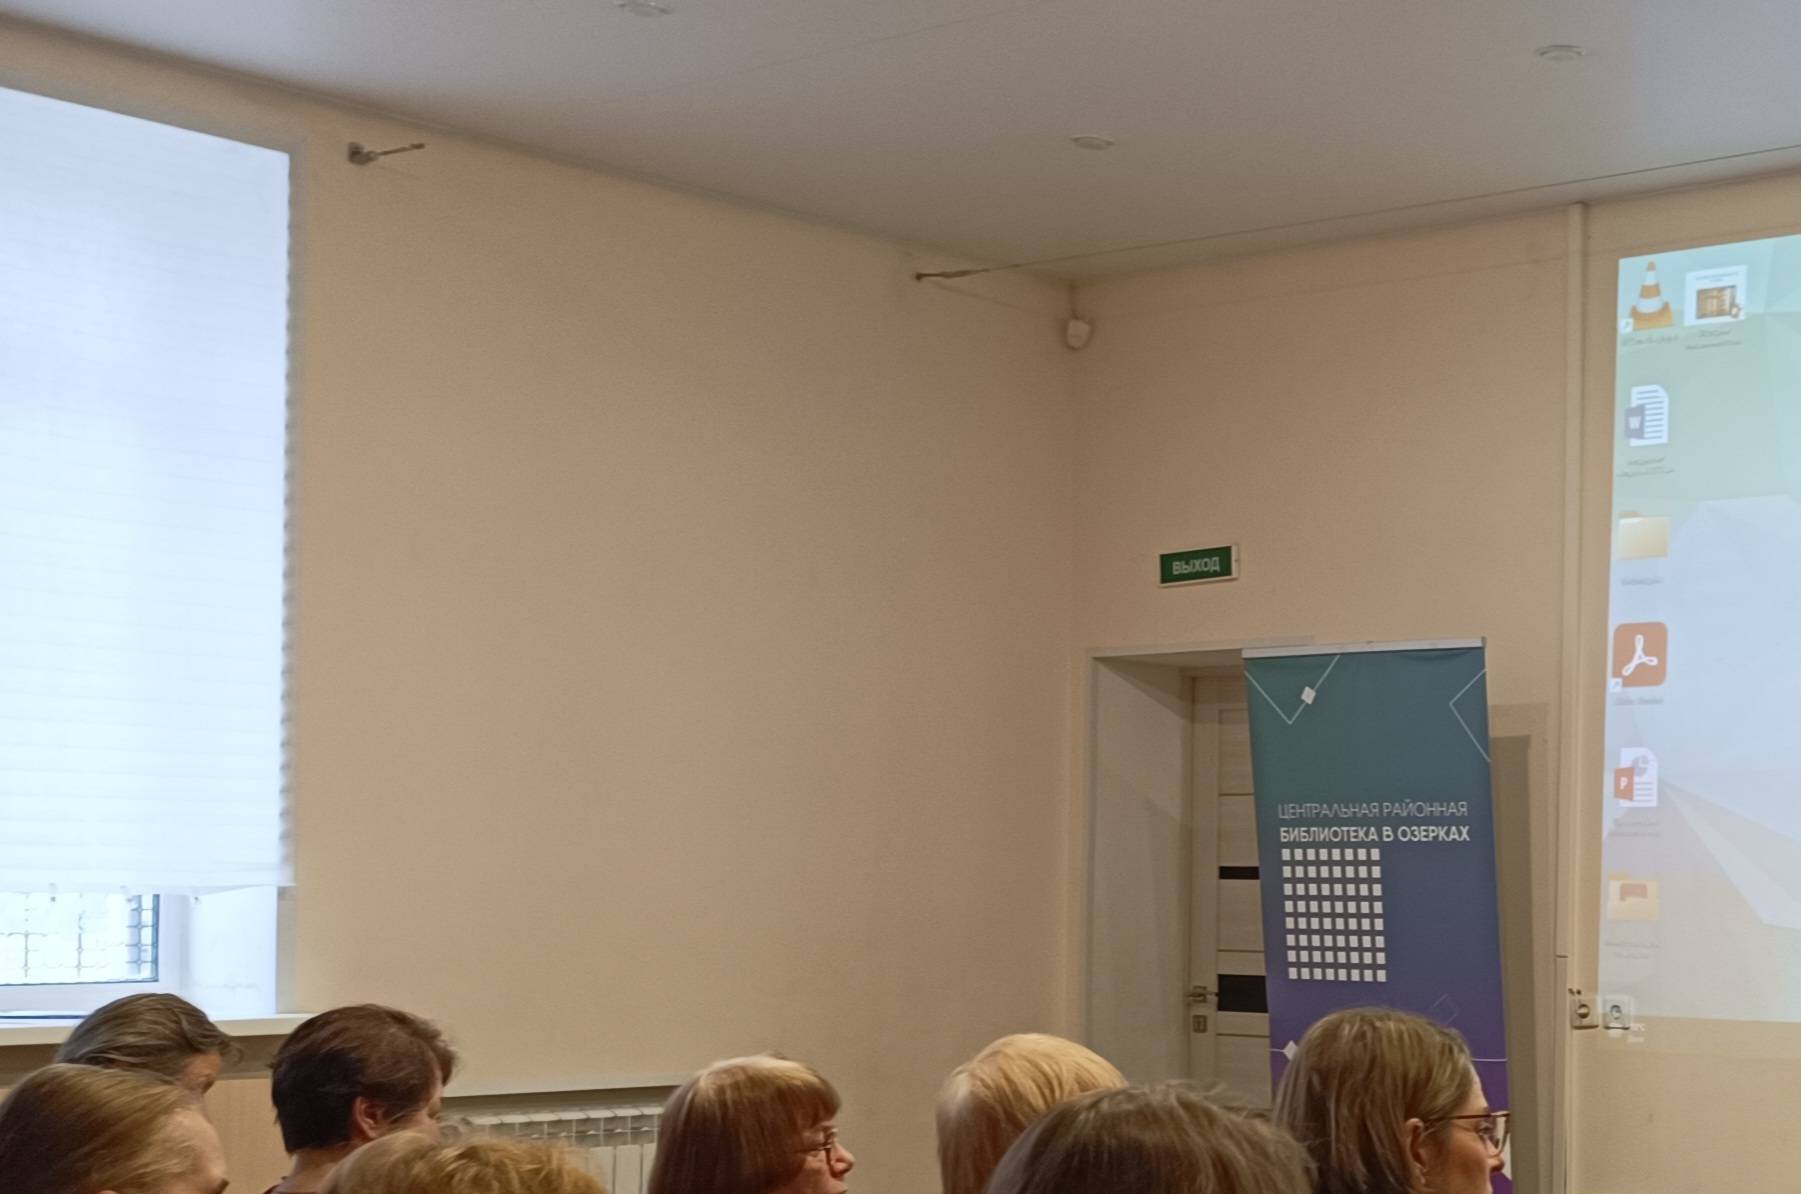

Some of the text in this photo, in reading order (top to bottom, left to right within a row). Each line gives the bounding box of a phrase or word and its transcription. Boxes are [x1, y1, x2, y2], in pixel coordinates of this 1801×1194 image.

[1172, 556, 1221, 575] ВЫХОД
[1277, 799, 1469, 820] ЦЕНТРАЛЬНАЯ РАЙОННАЯ
[1279, 825, 1471, 843] БИБЛИОТЕКА В ОЗЕРКАХ
